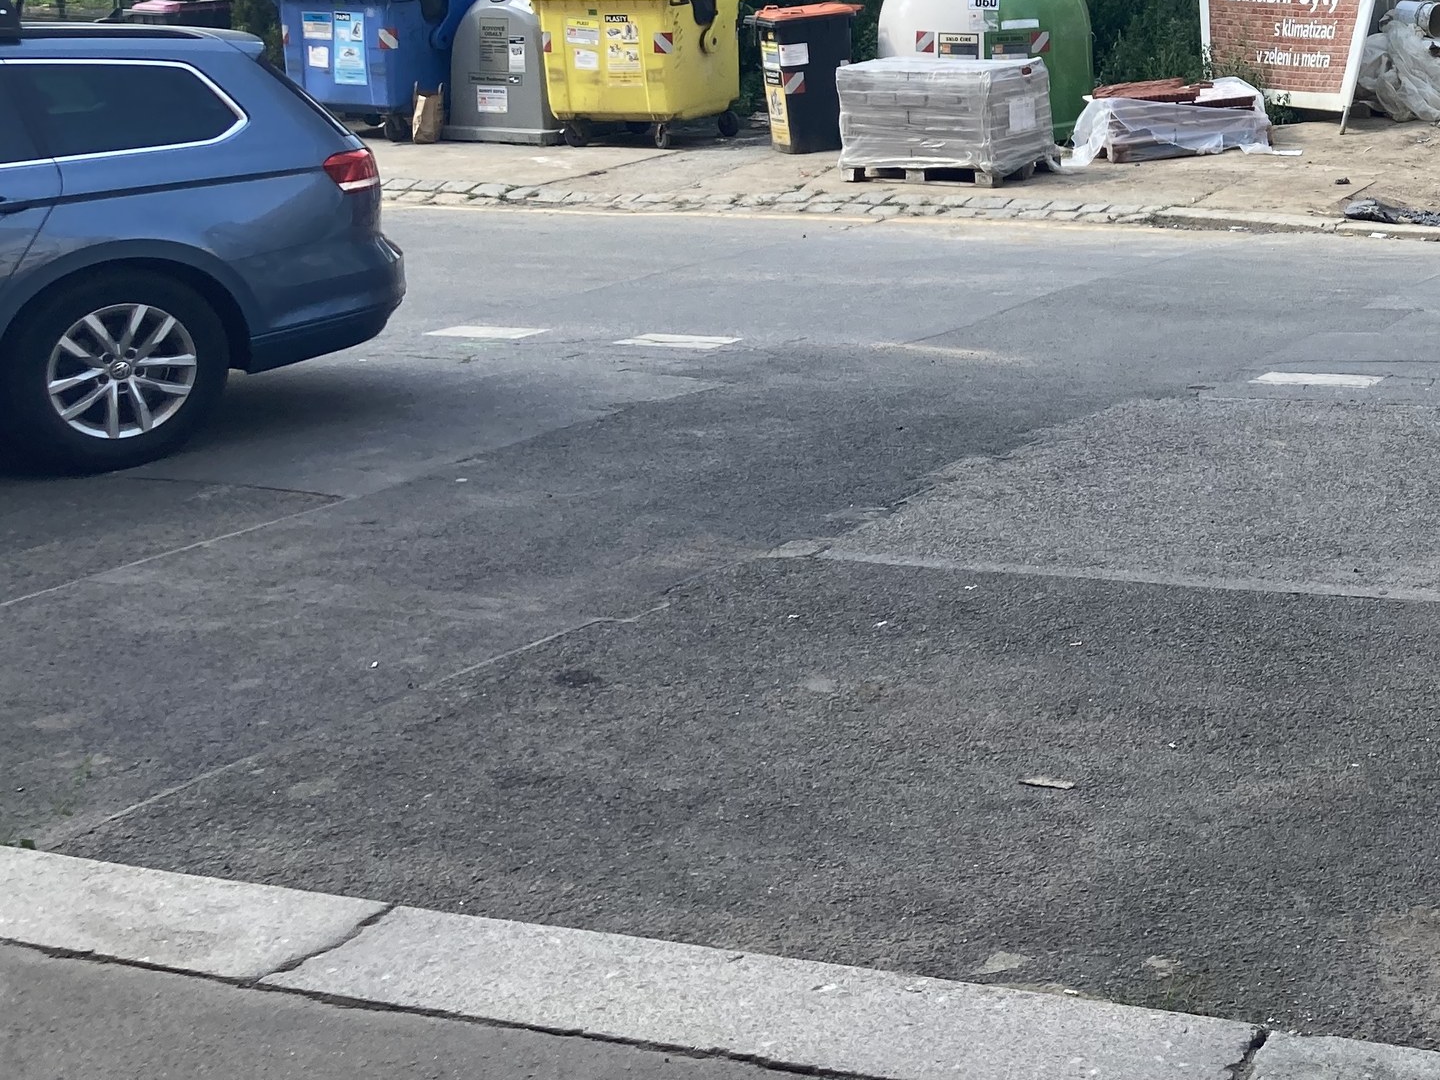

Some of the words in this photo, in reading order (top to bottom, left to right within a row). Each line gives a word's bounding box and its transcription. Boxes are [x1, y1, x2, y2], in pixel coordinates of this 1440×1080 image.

[1274, 23, 1281, 37] s
[1282, 18, 1338, 40] klimatizací
[1256, 49, 1264, 64] v
[1264, 46, 1293, 66] zelení
[1293, 53, 1300, 66] u
[1301, 49, 1331, 69] metra
